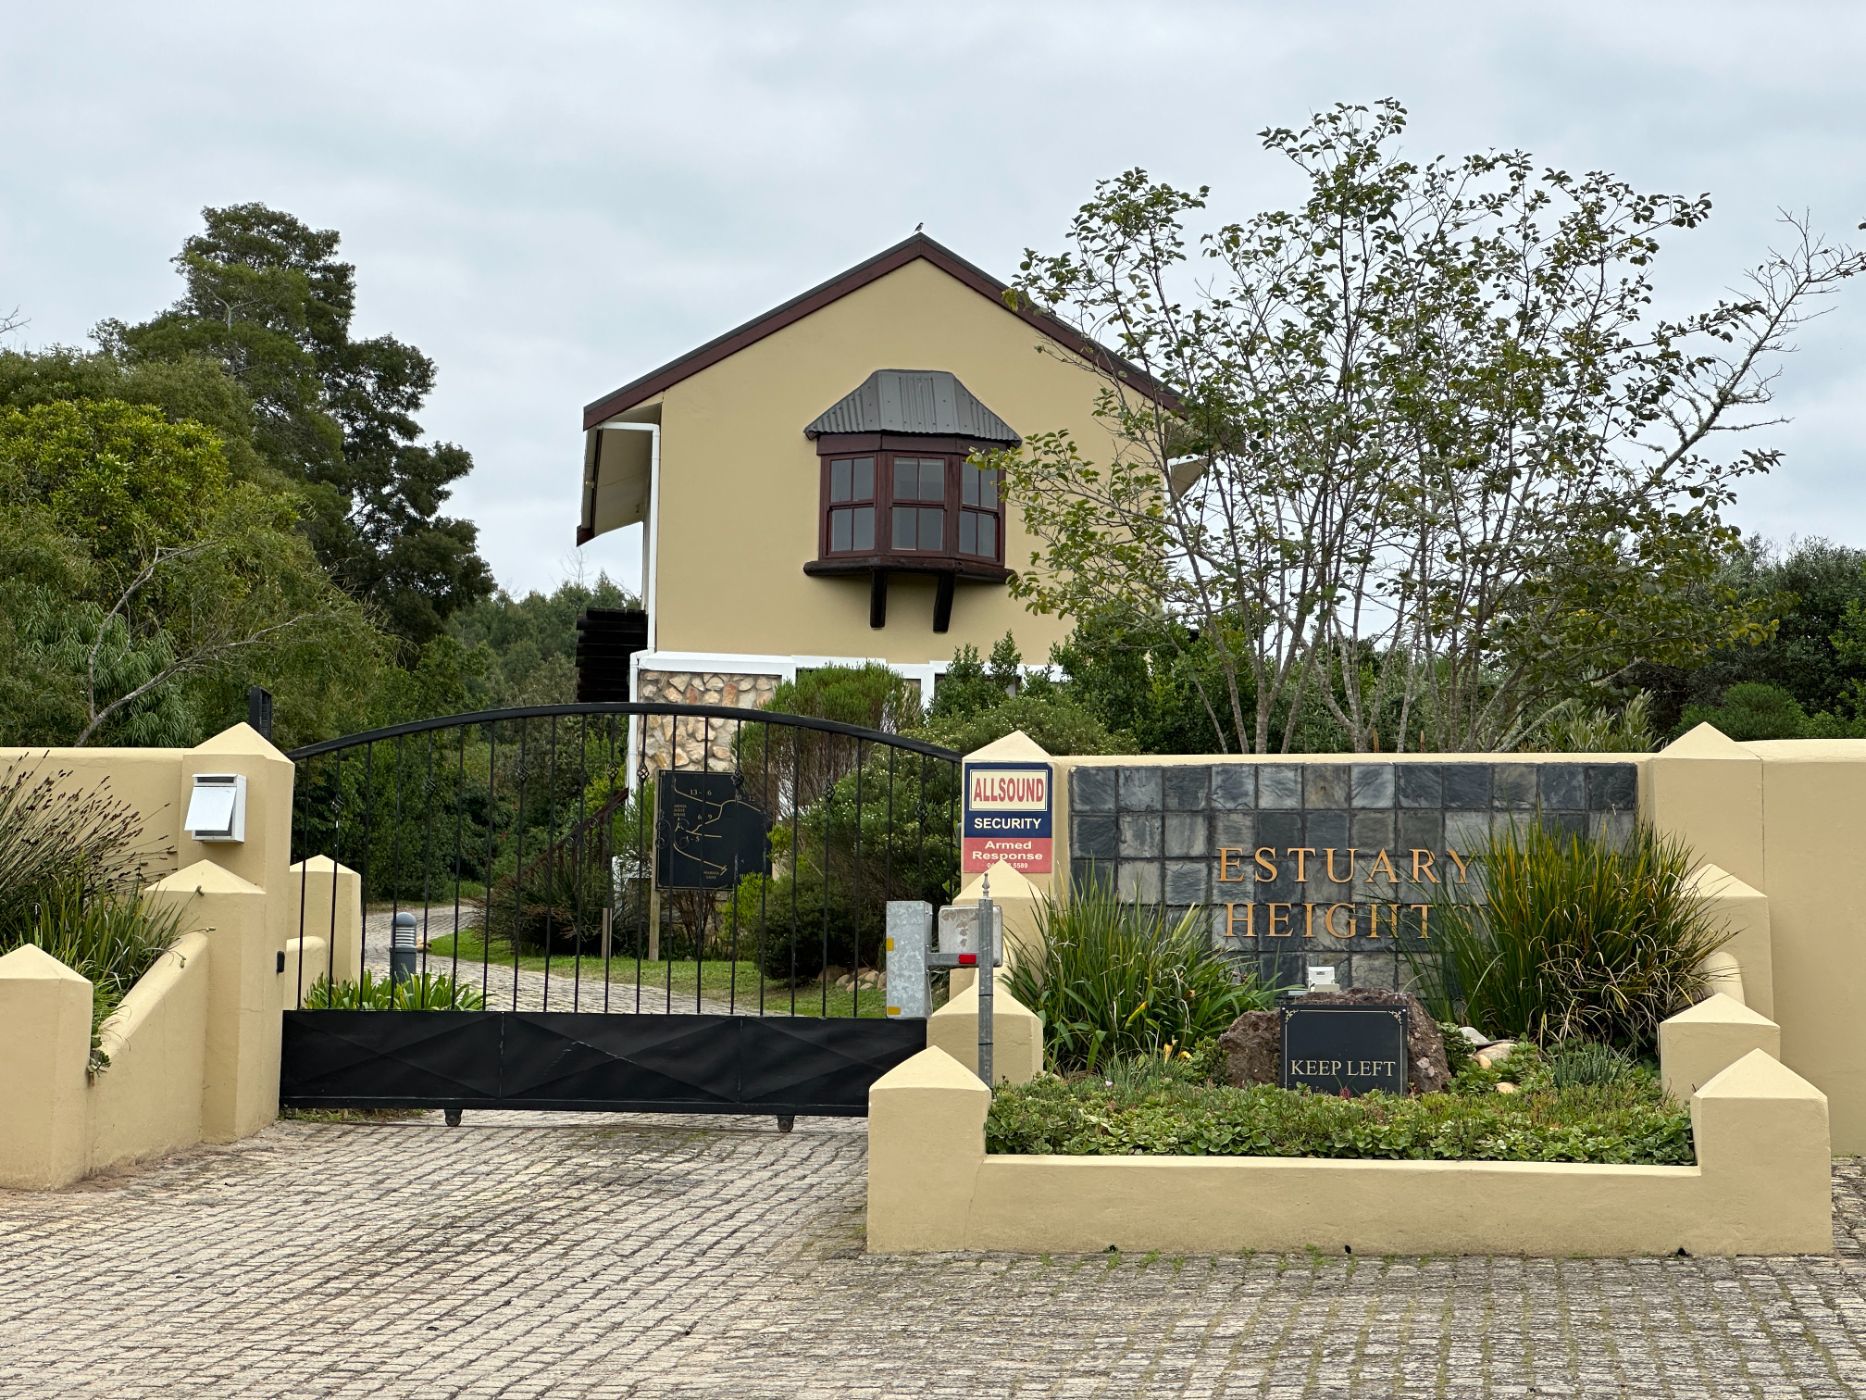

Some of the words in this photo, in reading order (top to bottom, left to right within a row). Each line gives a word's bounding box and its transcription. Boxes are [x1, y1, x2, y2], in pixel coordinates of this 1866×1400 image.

[973, 777, 1045, 803] ALLSOUND
[974, 818, 1042, 829] SECURITY
[985, 841, 1032, 850] Armed
[972, 851, 1043, 861] Response
[1216, 846, 1474, 885] ESTUARY
[1223, 902, 1473, 939] HEIGHT
[1290, 1060, 1342, 1076] KEEP
[1346, 1061, 1396, 1077] LEFT
